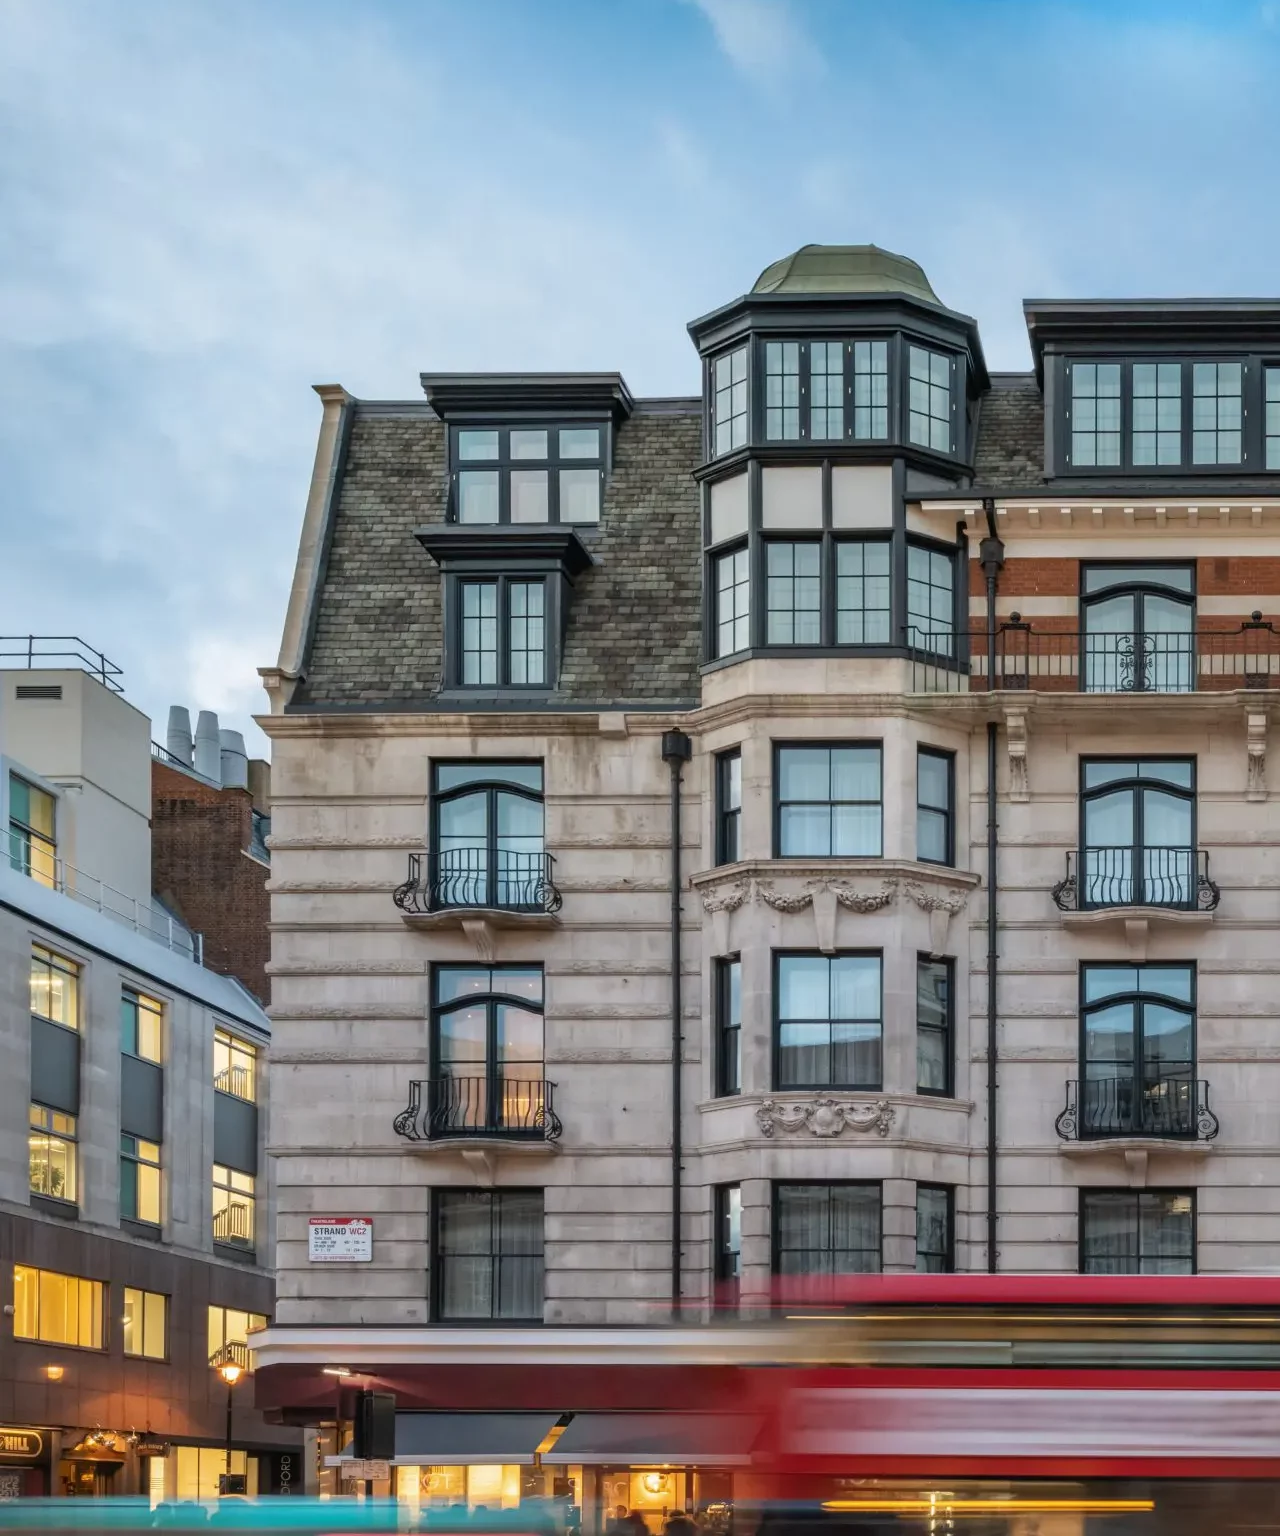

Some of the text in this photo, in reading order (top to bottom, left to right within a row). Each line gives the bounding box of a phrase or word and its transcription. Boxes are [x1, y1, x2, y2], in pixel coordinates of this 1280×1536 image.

[314, 1227, 367, 1235] STRAND WC2
[4, 1436, 30, 1451] HILL
